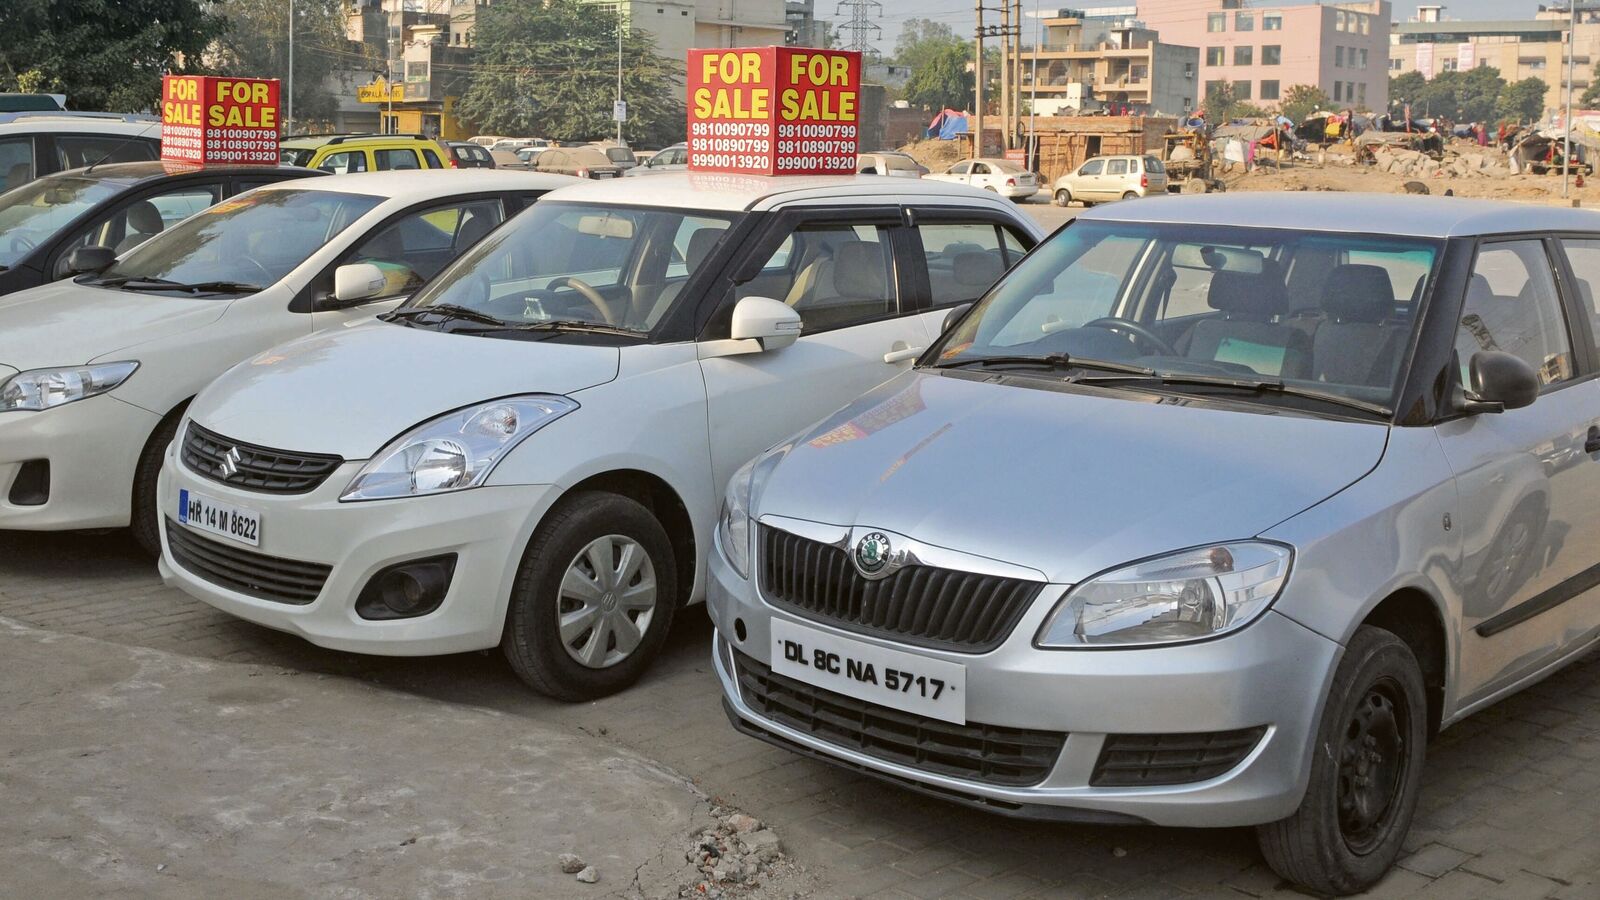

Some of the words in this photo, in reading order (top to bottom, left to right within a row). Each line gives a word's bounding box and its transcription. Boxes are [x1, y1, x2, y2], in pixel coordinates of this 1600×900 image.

[702, 52, 761, 84] FOR
[791, 54, 849, 86] FOR
[169, 79, 198, 101] FOR
[217, 81, 269, 104] FOR
[694, 88, 769, 119] SALE
[781, 89, 856, 121] SALE
[164, 102, 201, 125] SALE
[208, 105, 276, 128] SALE
[163, 126, 202, 138] 9810090799
[206, 129, 277, 139] 9810090799
[692, 123, 769, 136] 9810090799
[778, 125, 856, 138] 9810090799
[162, 137, 202, 149] 9810890799
[206, 140, 277, 150] 9810890799
[692, 139, 769, 152] 9810890799
[778, 141, 856, 153] 9810890799
[161, 147, 202, 160] 9990013920
[206, 151, 277, 161] 9990013920
[692, 154, 769, 169] 9990013920
[777, 157, 855, 169] 9990013920
[188, 500, 202, 523] HR
[205, 505, 217, 528] 14
[219, 510, 228, 531] M
[231, 514, 257, 540] 8622
[784, 640, 808, 665] DL
[814, 649, 840, 674] 8C
[847, 658, 878, 685] NA
[885, 668, 945, 700] 5717
